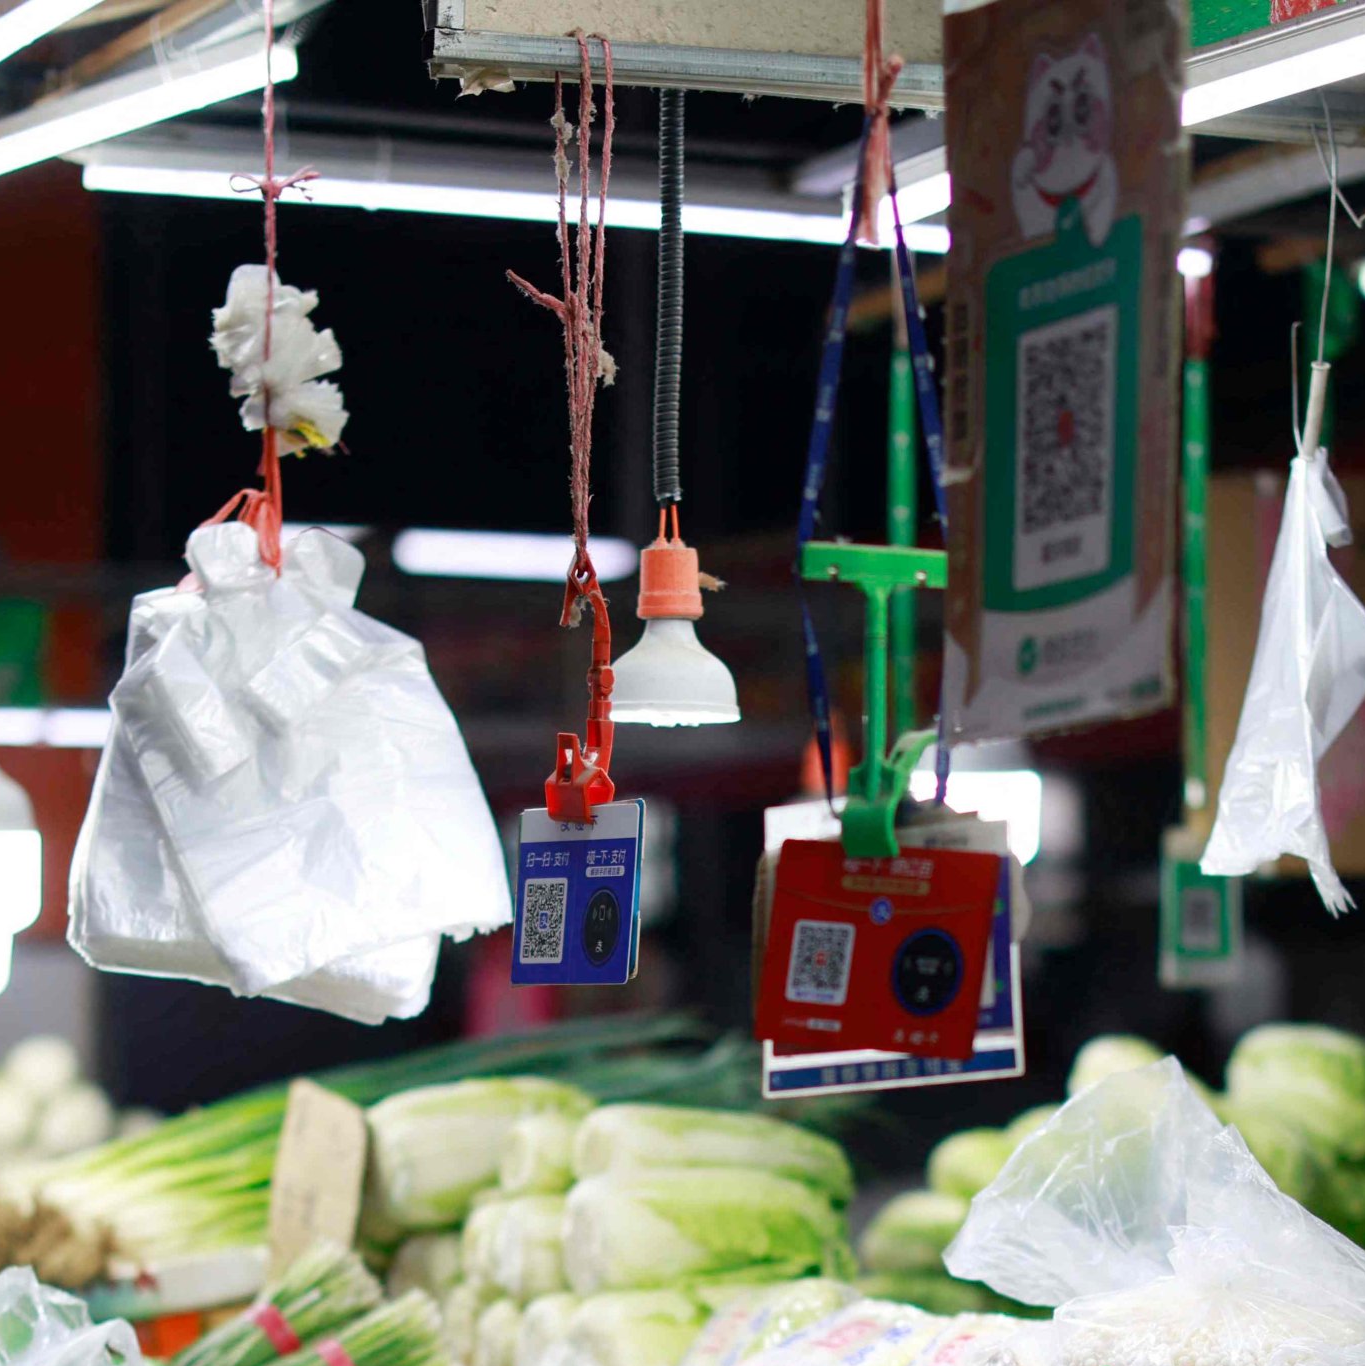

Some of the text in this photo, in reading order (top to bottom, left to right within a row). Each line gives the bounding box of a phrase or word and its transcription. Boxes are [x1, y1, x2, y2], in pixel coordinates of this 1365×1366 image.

[526, 852, 570, 867] 扫一扫·支付
[586, 849, 626, 864] 碰一下·支付
